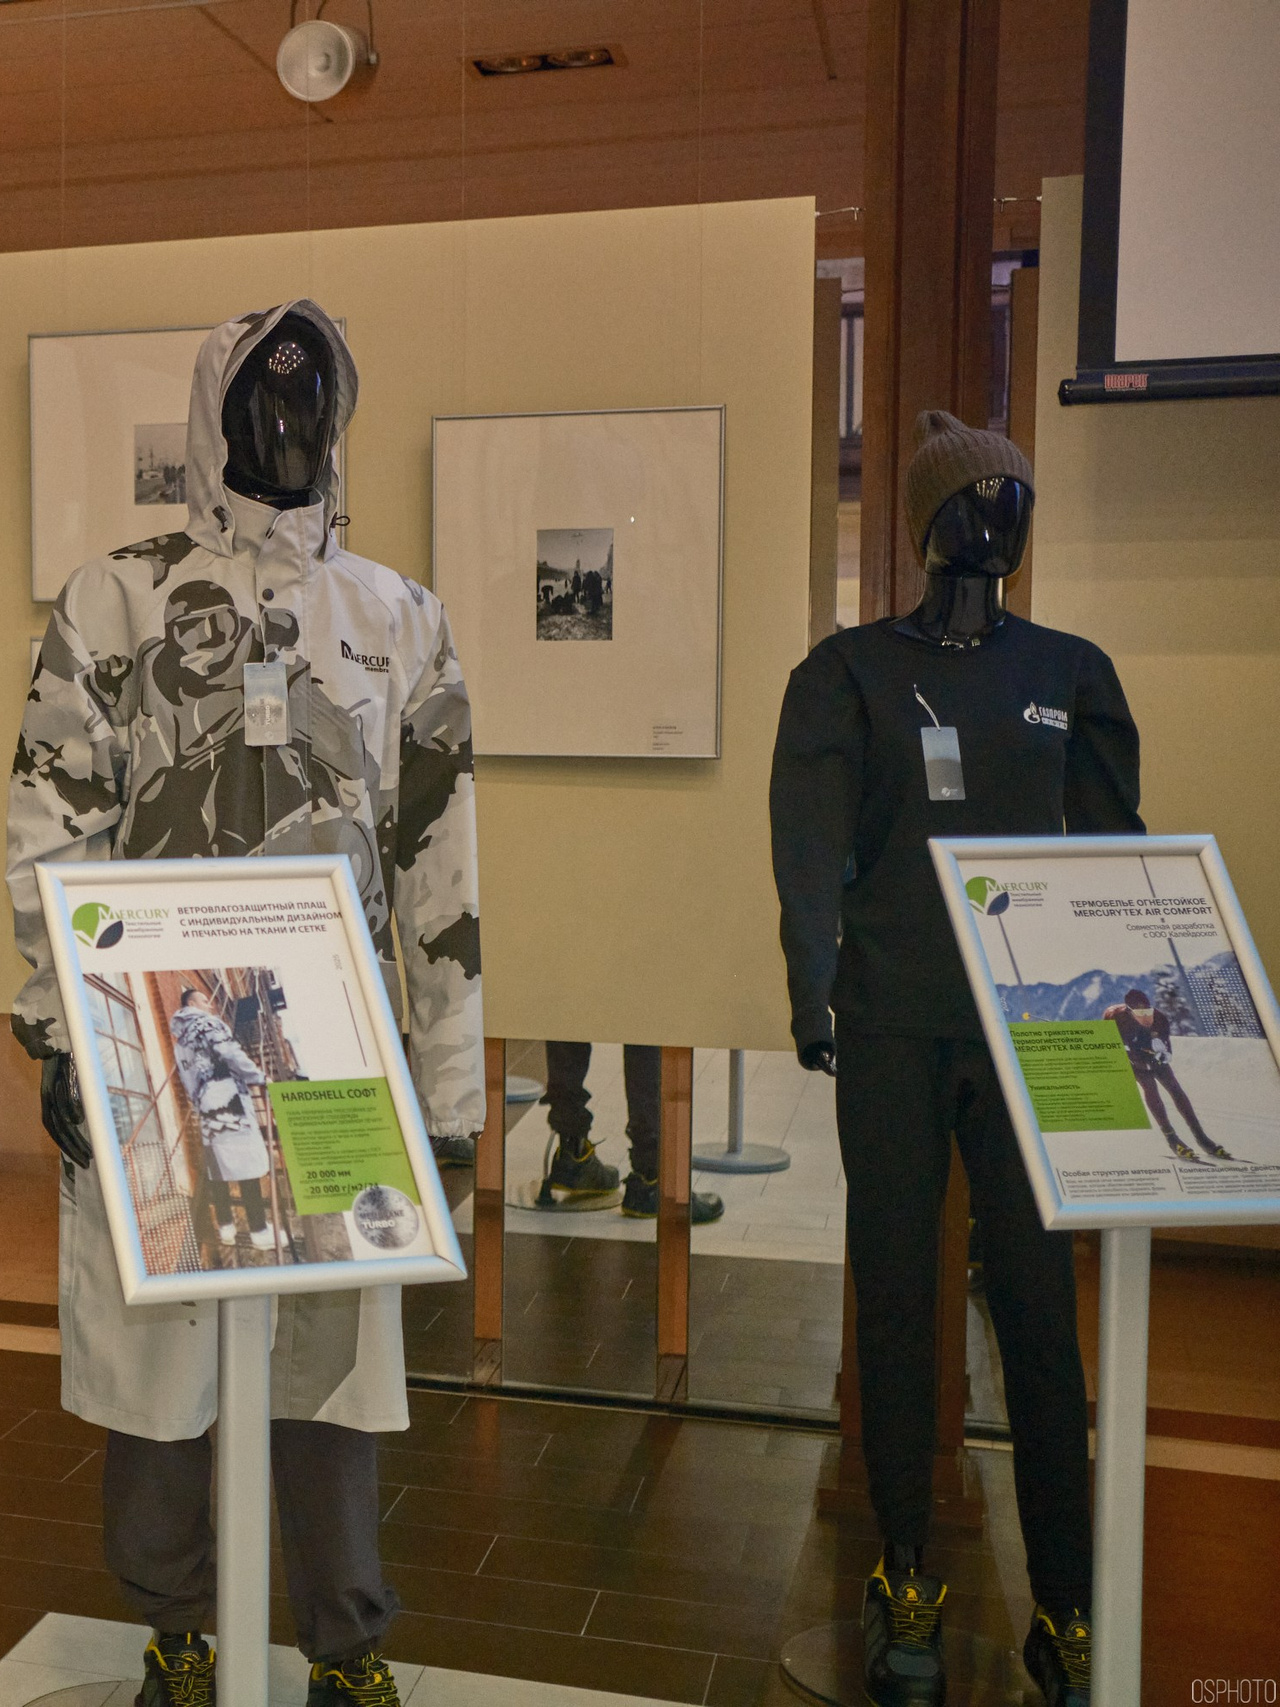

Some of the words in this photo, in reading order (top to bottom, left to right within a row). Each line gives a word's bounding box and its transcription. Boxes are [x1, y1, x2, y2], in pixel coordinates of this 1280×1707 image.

[985, 880, 1048, 891] MERCURY
[1070, 900, 1134, 908] ТЕРМОБЕЛЬЕ
[1136, 897, 1207, 907] ОГНЕСТОЙКОЕ
[97, 906, 170, 920] MERCURY
[177, 901, 295, 915] ВЕТРОВЛАГОЗАЩИТНЫЙ
[297, 901, 327, 910] ПЛАЩ
[1145, 908, 1161, 916] AIR
[1163, 907, 1213, 916] COMFORT
[180, 919, 186, 927] С
[188, 915, 285, 926] ИНДИВИДУАЛЬНЫМ
[287, 911, 343, 922] ДИЗАЙНОМ
[182, 930, 190, 938] И
[192, 928, 238, 938] ПЕЧАТЬЮ
[240, 928, 253, 936] НА
[255, 927, 287, 935] ТКАНИ
[289, 926, 296, 934] И
[298, 924, 327, 933] СЕТКЕ
[1126, 923, 1170, 931] Совместная
[1172, 922, 1215, 931] разработка
[1169, 929, 1218, 938] Калейдоскоп
[1044, 1029, 1095, 1038] трикотажное
[1083, 1042, 1122, 1050] COMFORT
[281, 1089, 346, 1102] HARDSHELL
[307, 1171, 317, 1180] 20
[319, 1169, 336, 1179] 000
[1092, 1169, 1129, 1178] структура
[310, 1185, 320, 1194] 20
[323, 1184, 340, 1193] 000
[361, 1220, 395, 1230] TURBO
